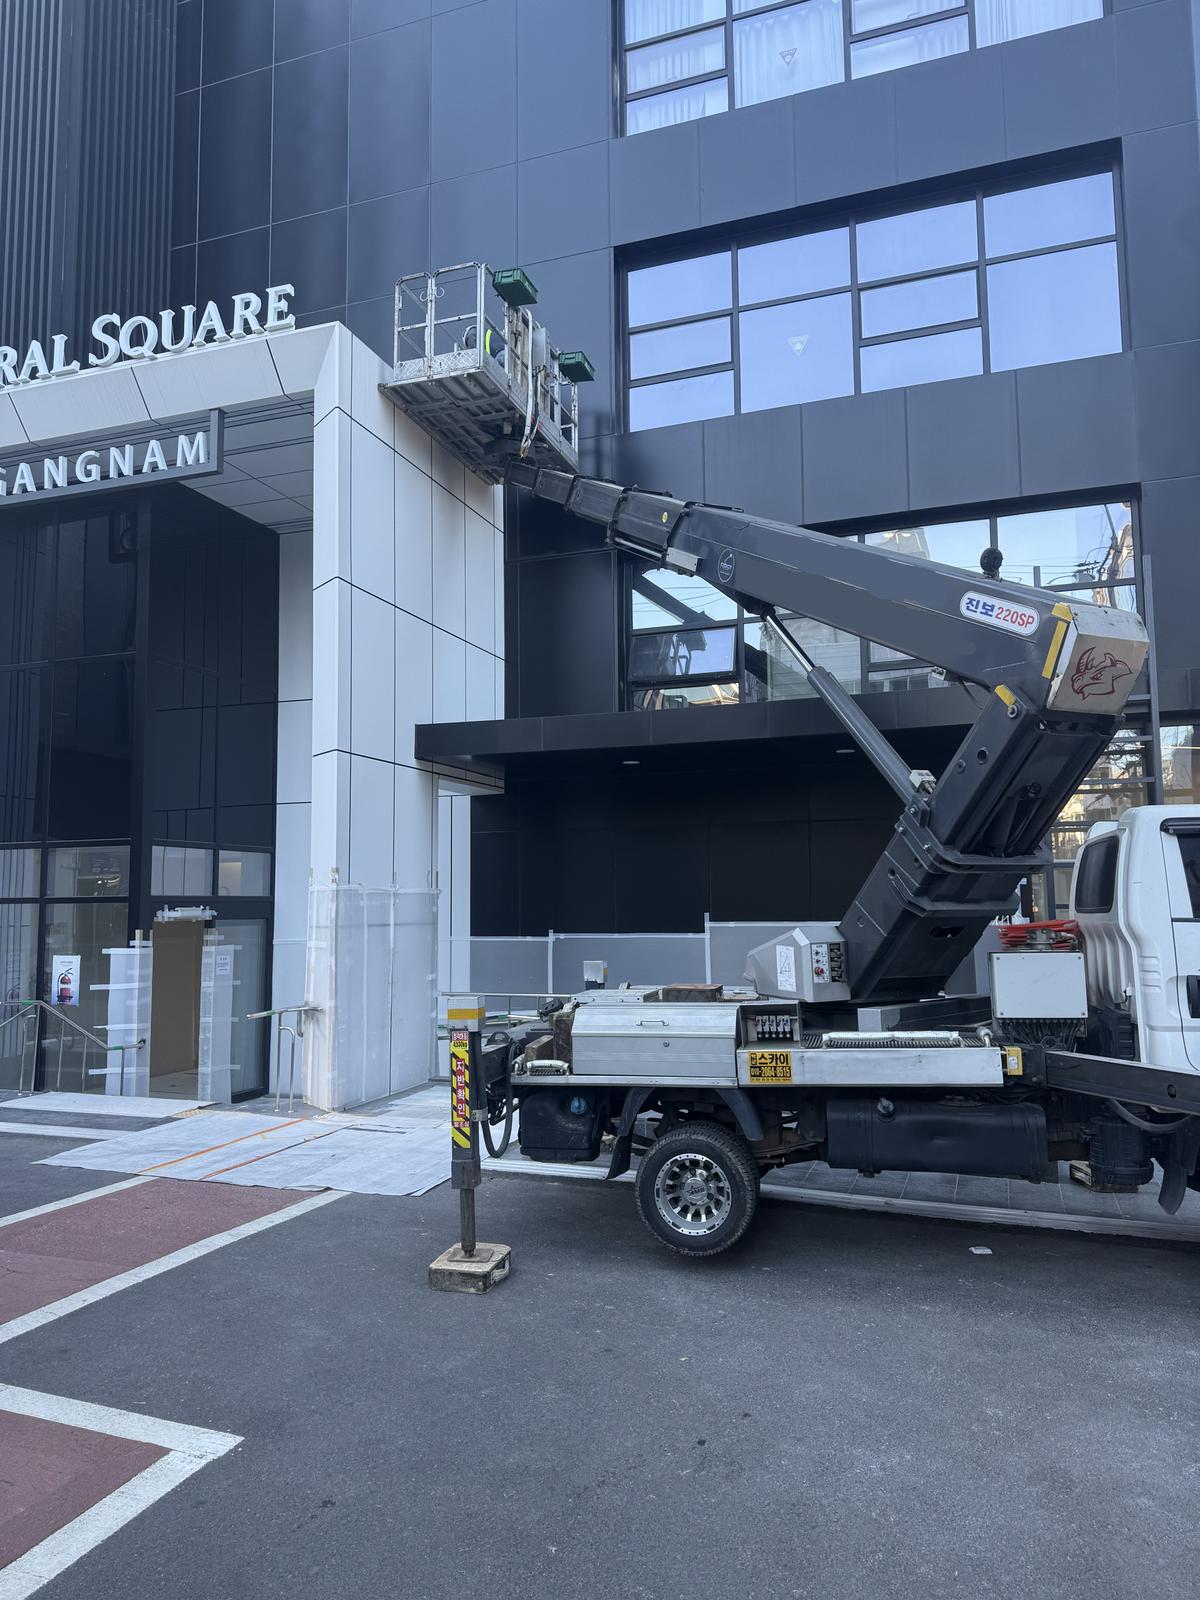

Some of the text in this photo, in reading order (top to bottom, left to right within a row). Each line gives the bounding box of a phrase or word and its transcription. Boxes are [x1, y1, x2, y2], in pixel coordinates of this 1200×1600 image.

[89, 283, 296, 367] SQUARE
[0, 431, 208, 497] ANGNAM
[456, 1061, 466, 1116] 지반확인
[758, 1053, 789, 1066] 스카이
